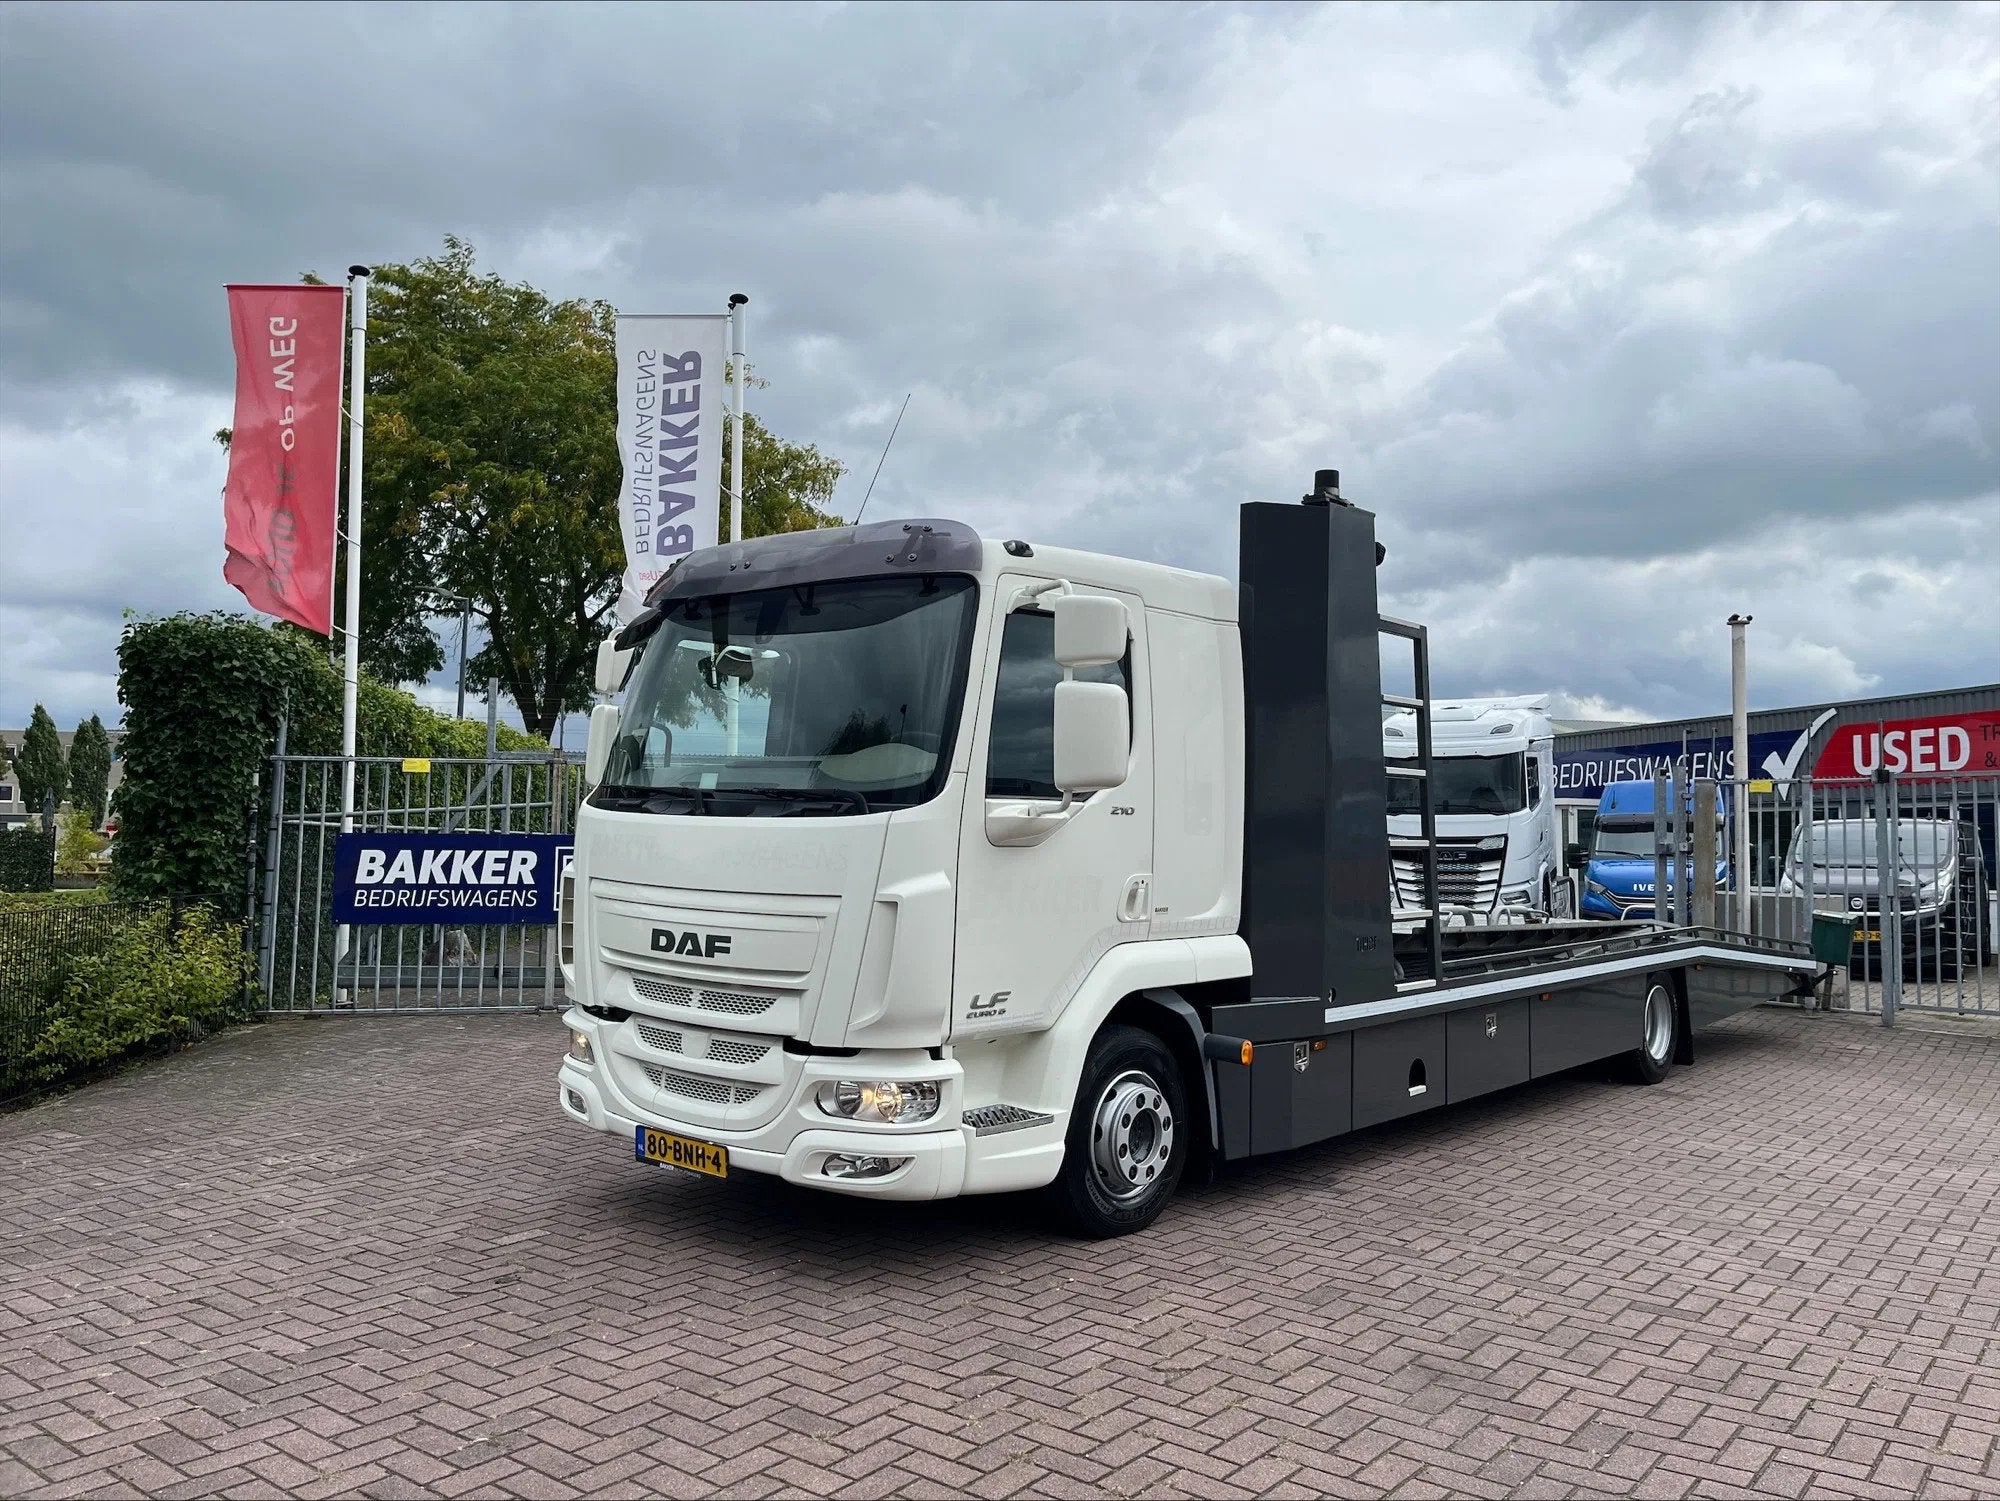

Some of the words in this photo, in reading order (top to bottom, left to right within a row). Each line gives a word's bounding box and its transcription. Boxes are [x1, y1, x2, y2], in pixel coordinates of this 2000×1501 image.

[1853, 727, 1970, 776] USED
[1437, 851, 1467, 861] AF
[355, 849, 538, 885] BAKKER
[1633, 883, 1674, 892] IVEO
[354, 889, 538, 907] BEDRIJFSWAGENS
[650, 928, 732, 958] DAF
[969, 990, 1012, 1010] LF
[966, 1009, 997, 1019] EURO
[647, 1133, 722, 1173] 80-BNH-4
